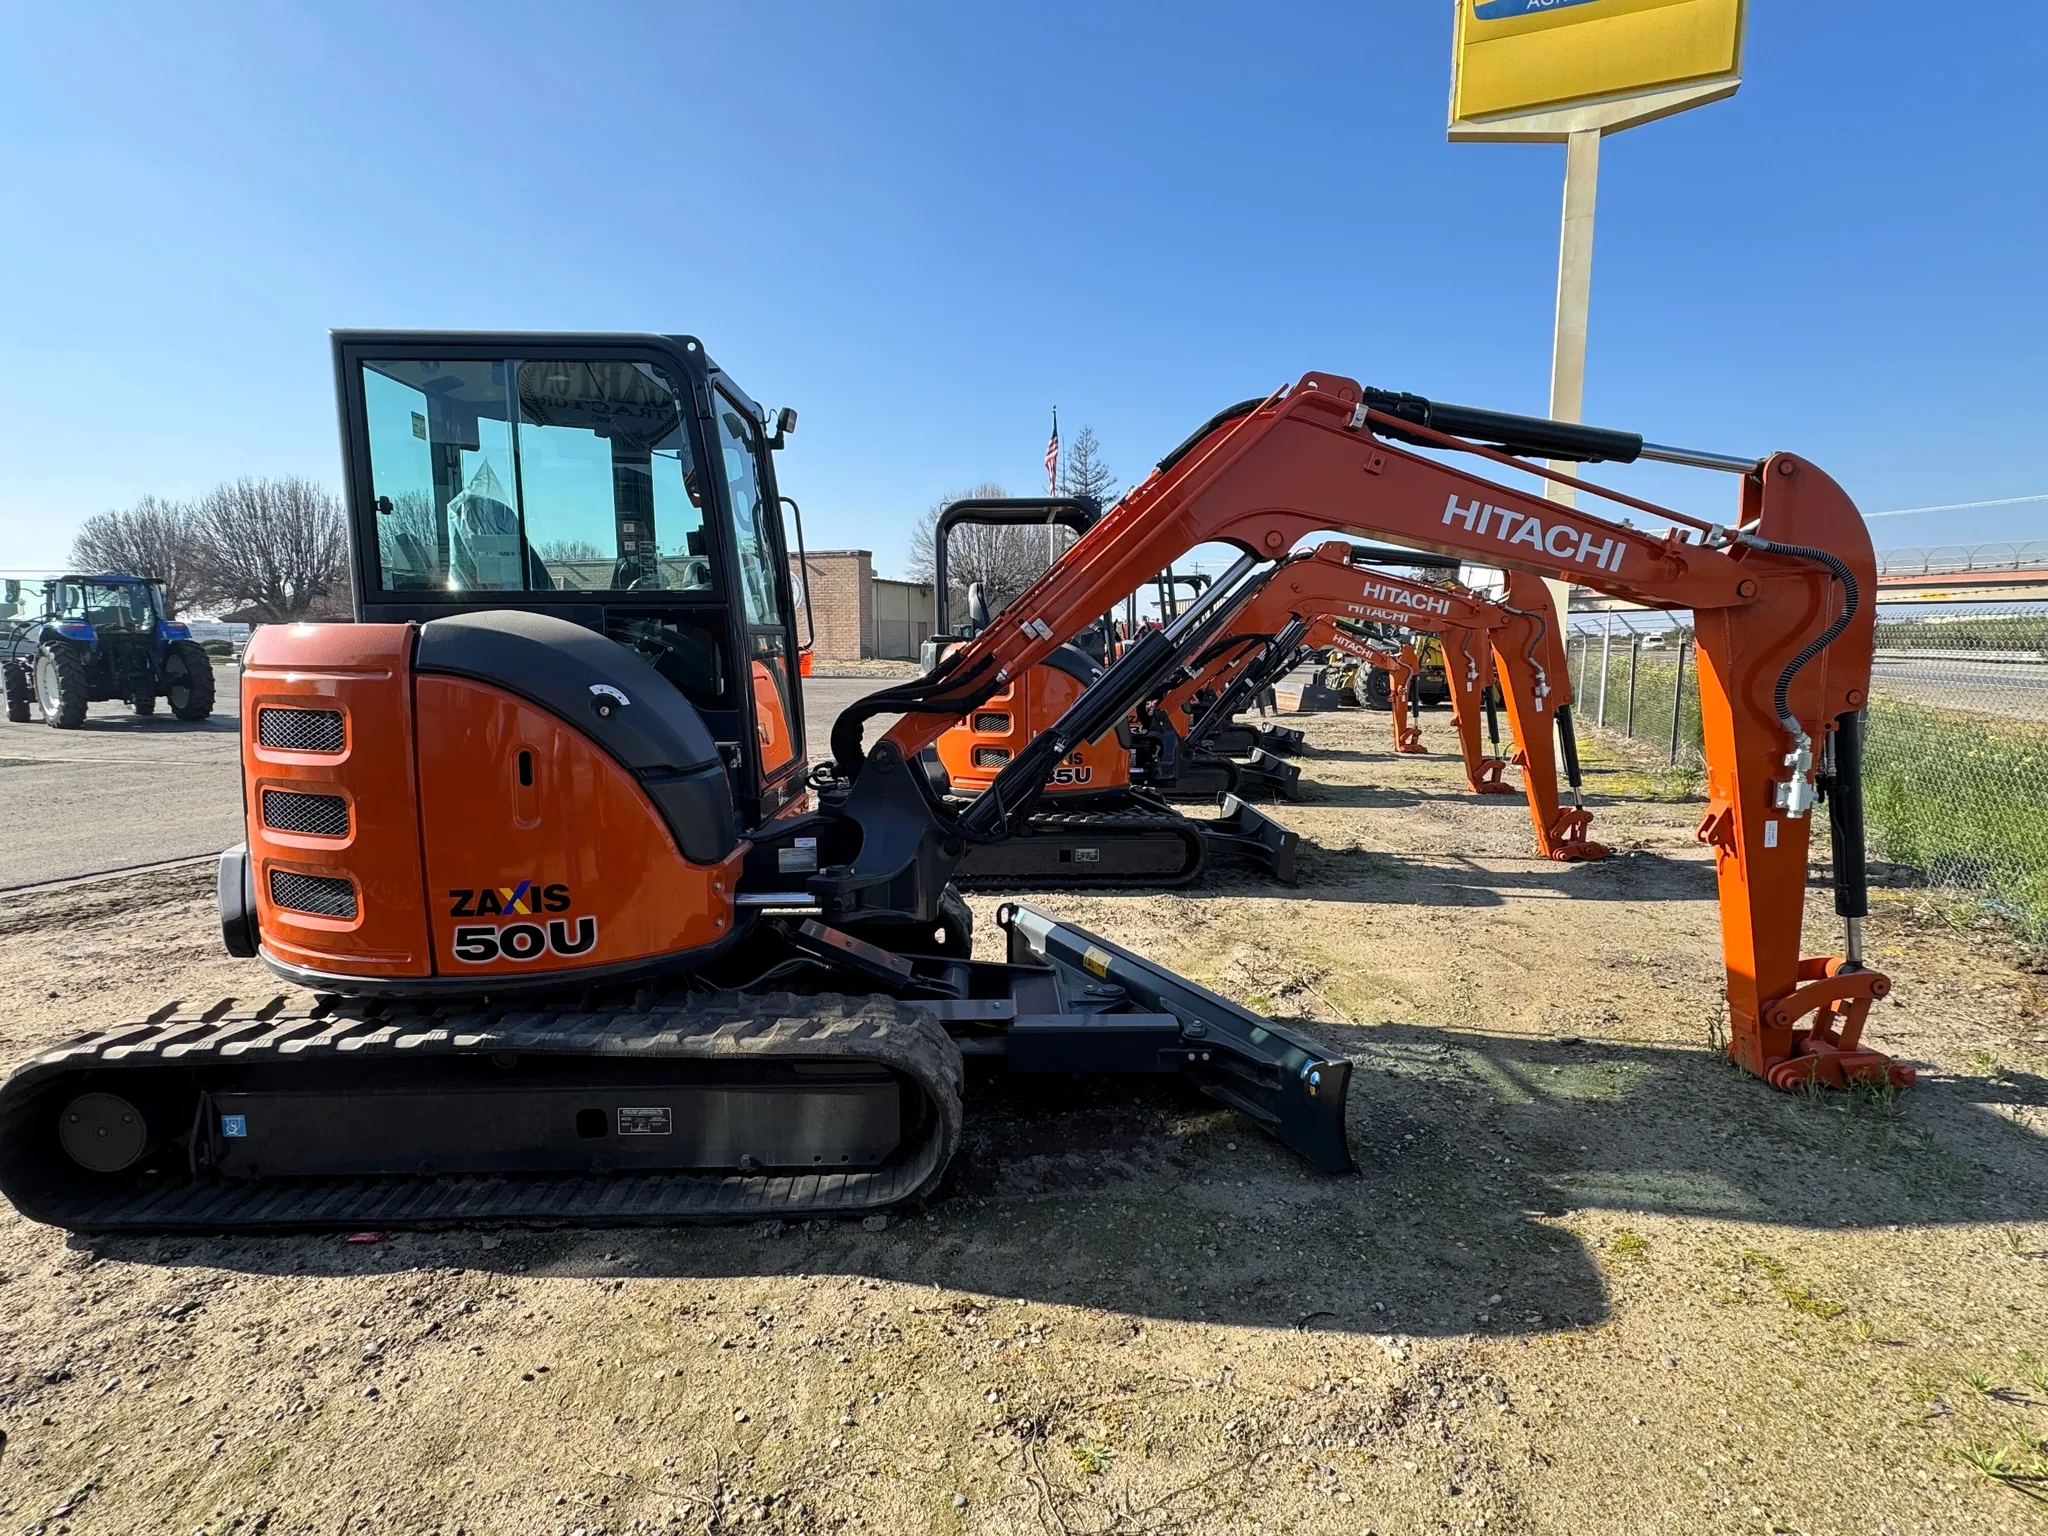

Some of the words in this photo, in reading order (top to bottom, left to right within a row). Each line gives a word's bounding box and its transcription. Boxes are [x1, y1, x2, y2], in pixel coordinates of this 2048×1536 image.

[1441, 494, 1627, 573] HITACHI
[1362, 581, 1451, 615] HITACHI
[1332, 634, 1374, 659] HITACHI
[449, 879, 572, 917] ZAXIS
[452, 915, 598, 965] 50U
